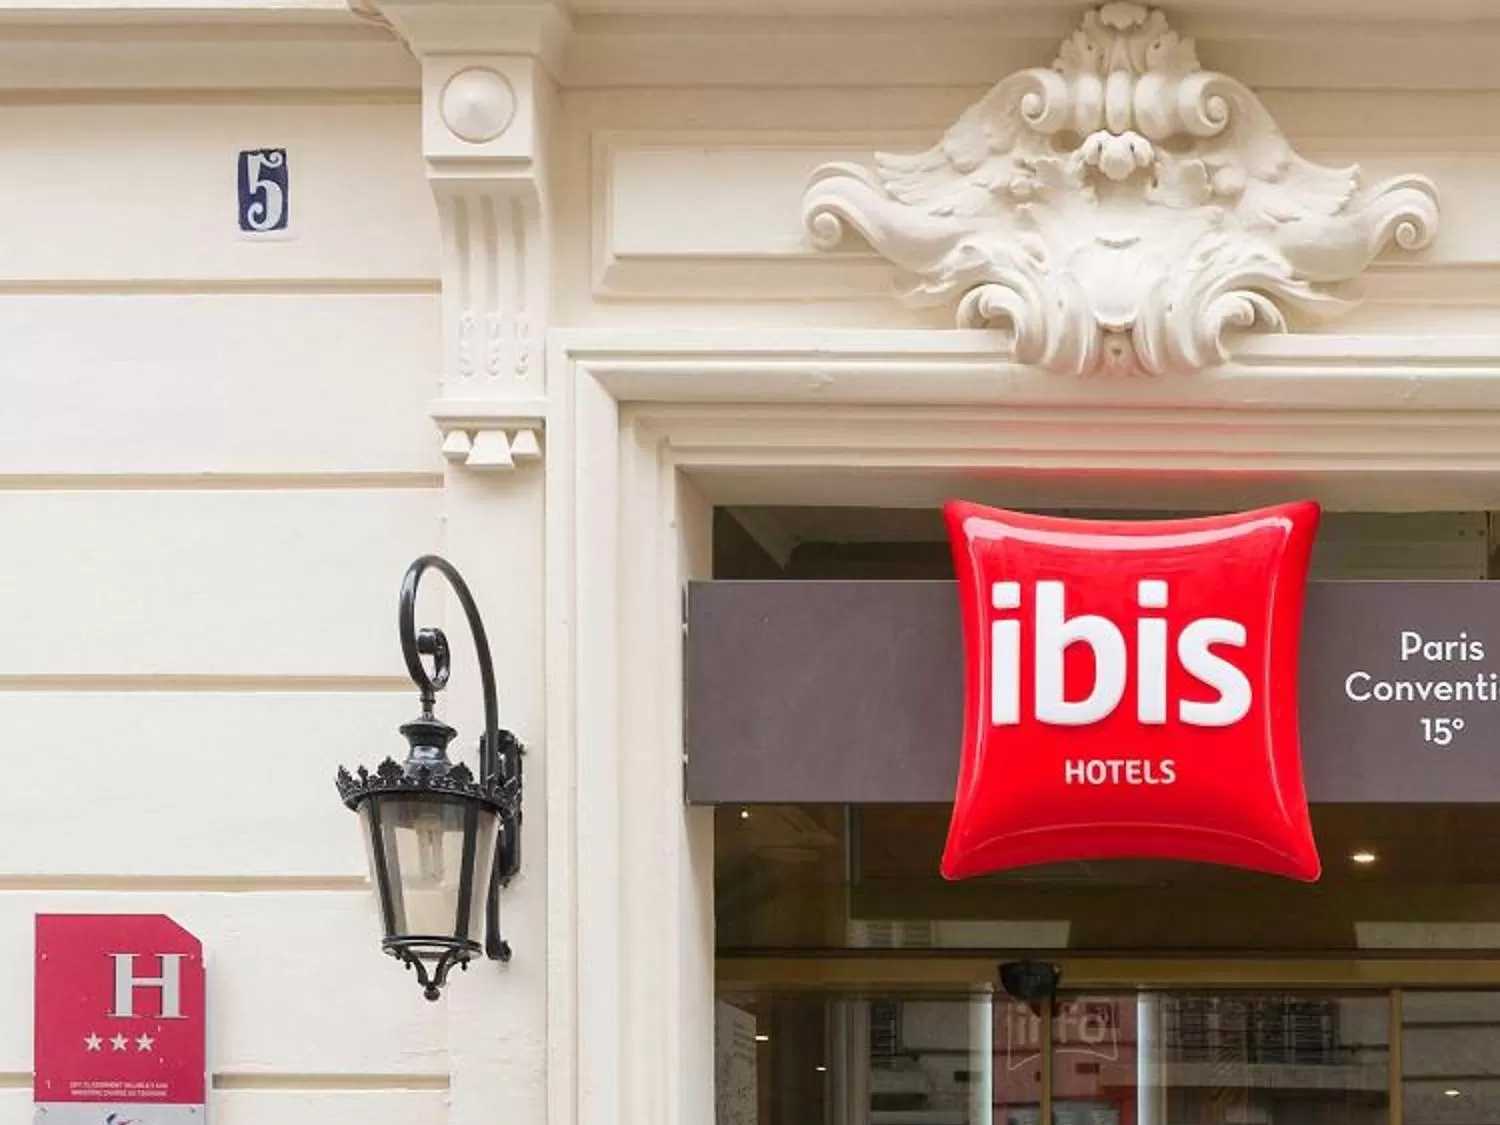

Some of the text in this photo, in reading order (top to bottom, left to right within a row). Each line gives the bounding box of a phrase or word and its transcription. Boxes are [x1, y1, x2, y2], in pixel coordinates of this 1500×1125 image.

[247, 151, 283, 231] 5
[991, 579, 1253, 727] ibis
[1400, 631, 1485, 661] Paris
[1064, 759, 1177, 785] HOTELS
[106, 953, 189, 1018] H
